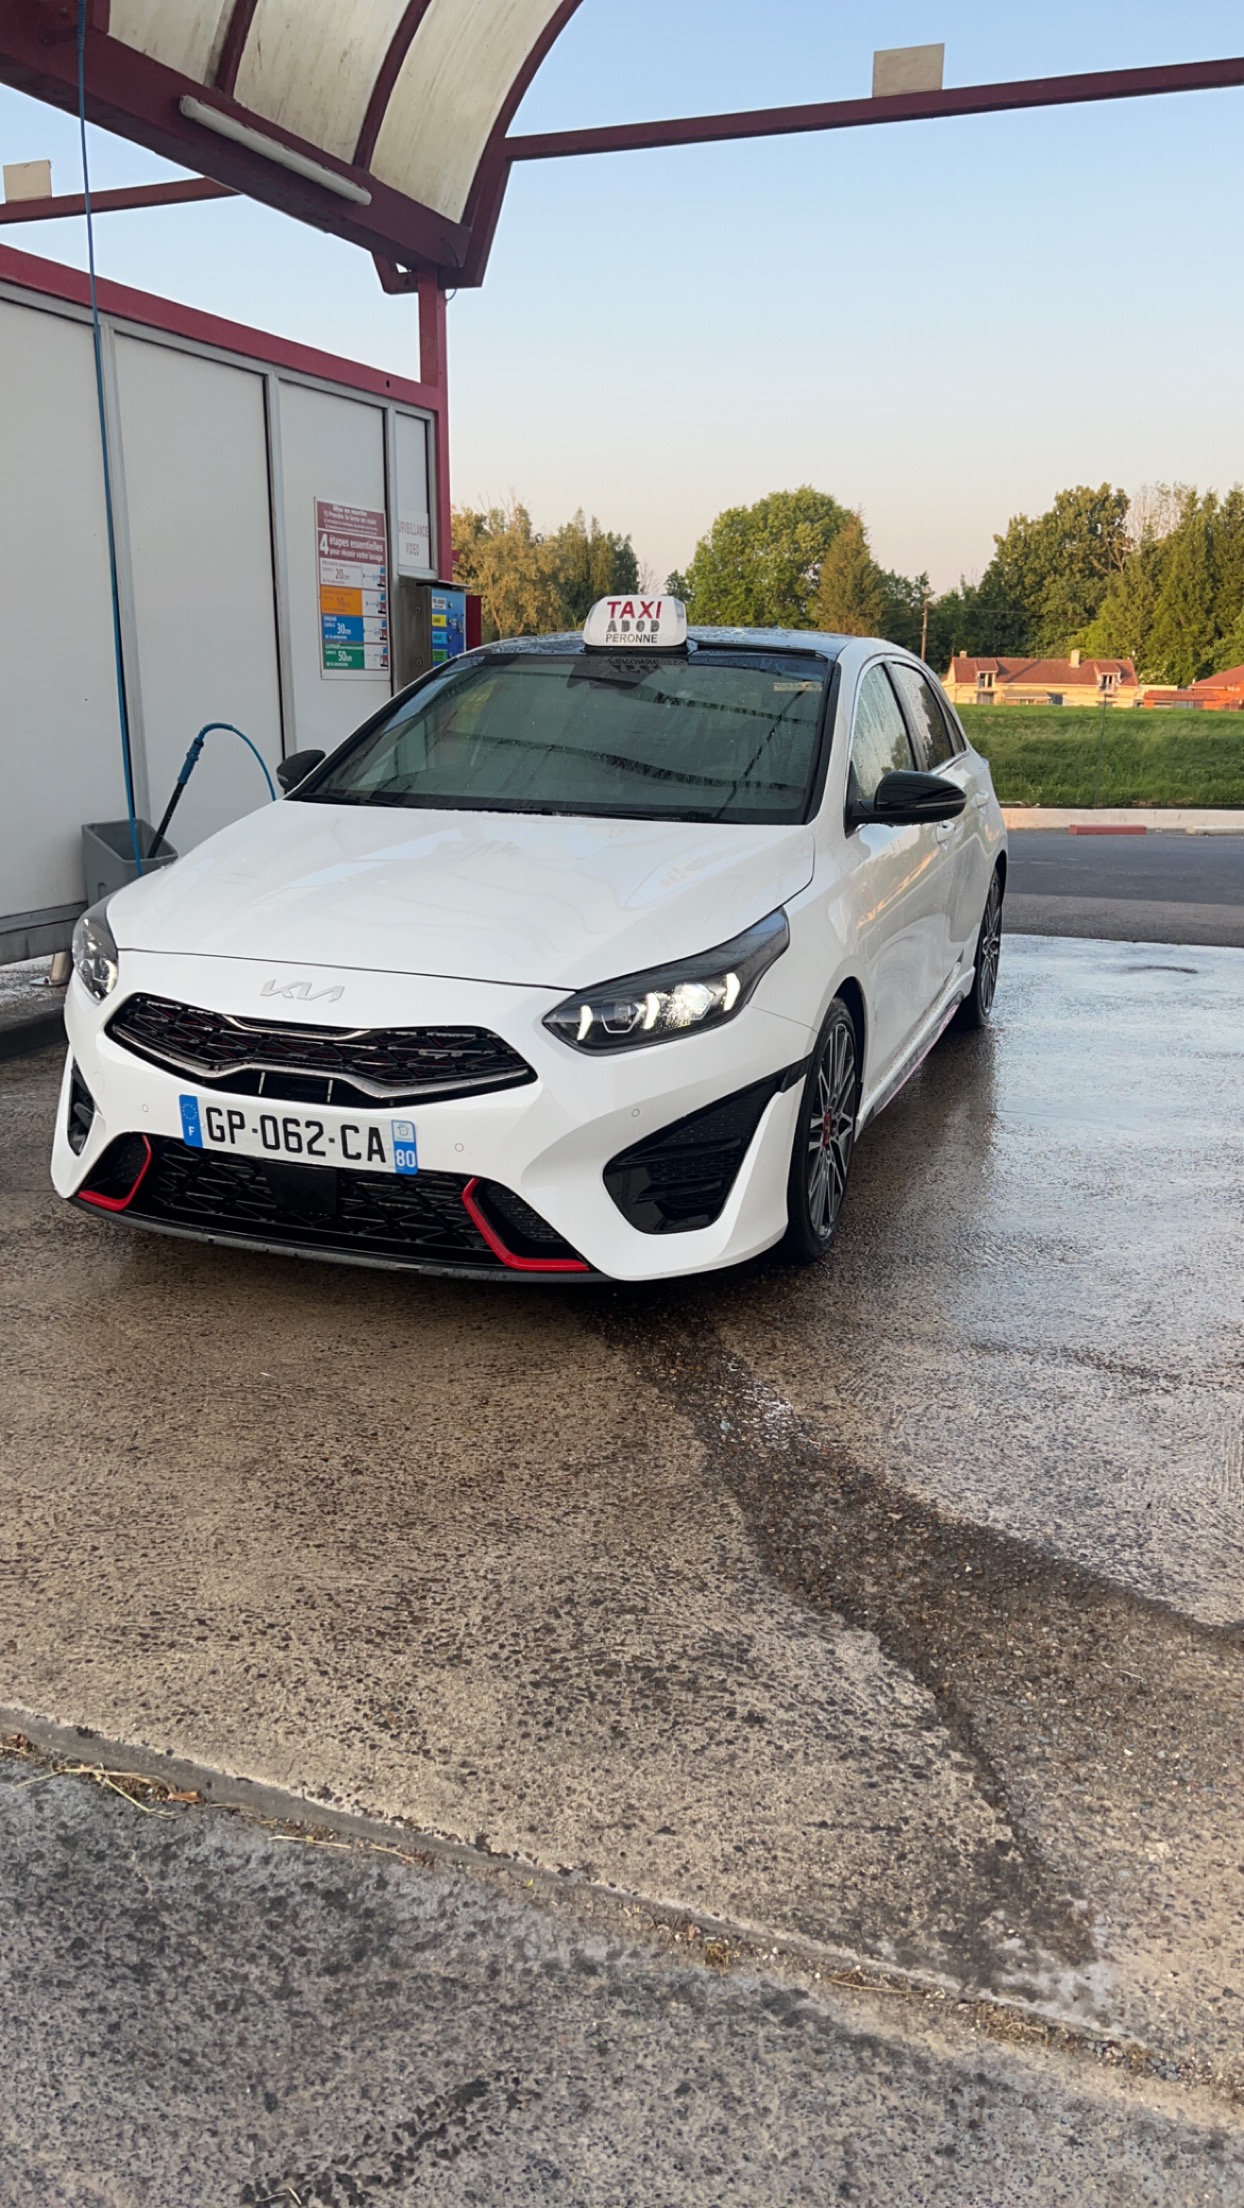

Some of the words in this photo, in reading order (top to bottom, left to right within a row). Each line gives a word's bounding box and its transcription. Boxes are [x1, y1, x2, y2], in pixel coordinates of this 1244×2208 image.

[320, 534, 328, 554] 4
[330, 535, 348, 548] étapes
[351, 540, 383, 552] essentielles
[608, 602, 662, 618] TAXI
[606, 634, 658, 644] PERONNE
[260, 979, 345, 1003] KIA
[187, 1126, 195, 1137] F
[206, 1106, 386, 1163] GP-062-CA
[395, 1149, 417, 1168] 80
